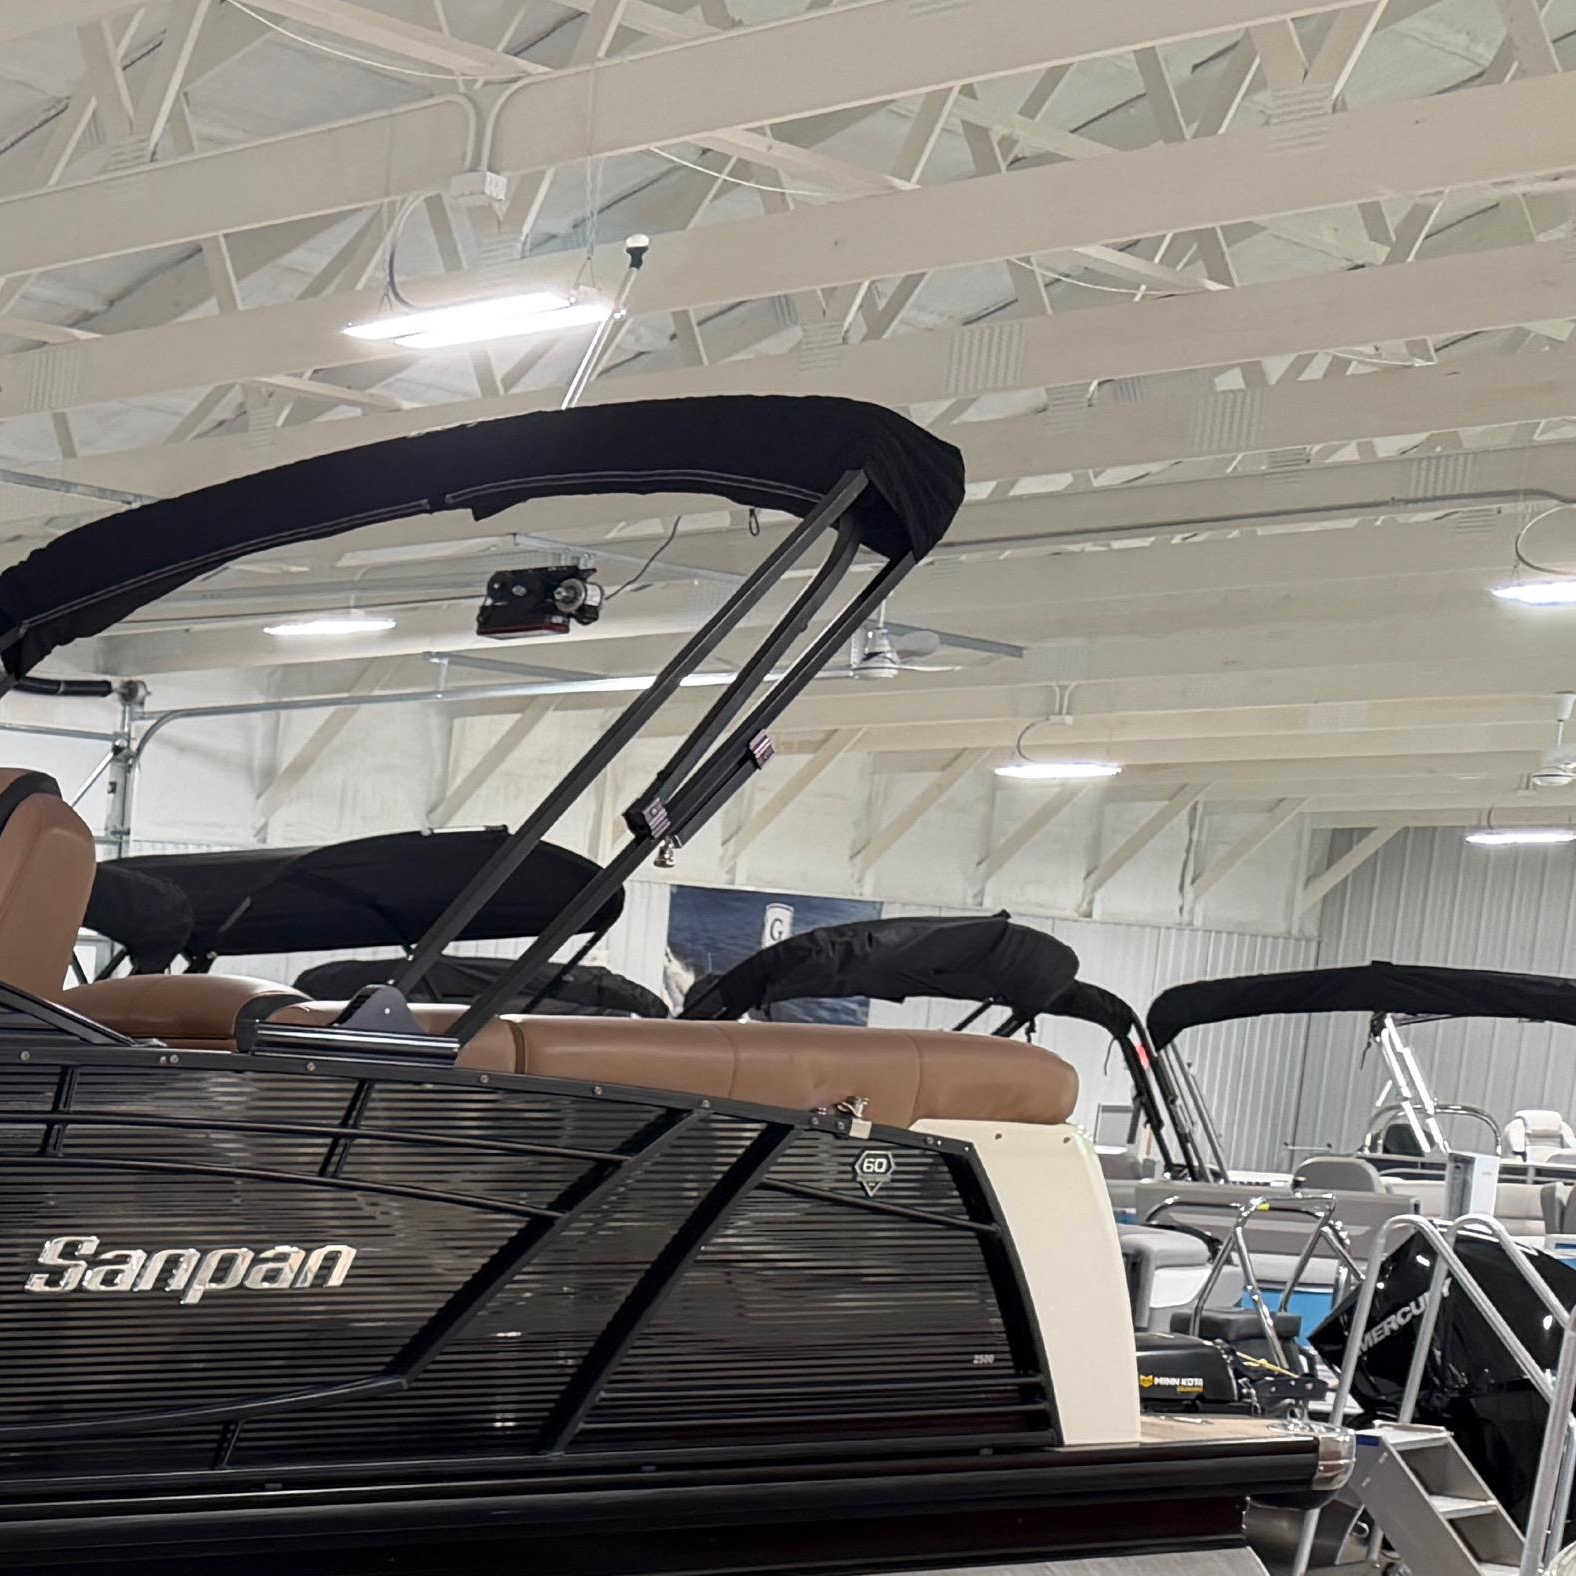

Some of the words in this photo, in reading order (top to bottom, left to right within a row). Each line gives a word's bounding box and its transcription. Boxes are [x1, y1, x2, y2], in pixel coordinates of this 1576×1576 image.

[862, 1158, 888, 1173] 60
[24, 1235, 358, 1305] Sanpan
[1356, 1276, 1453, 1358] MERCUY
